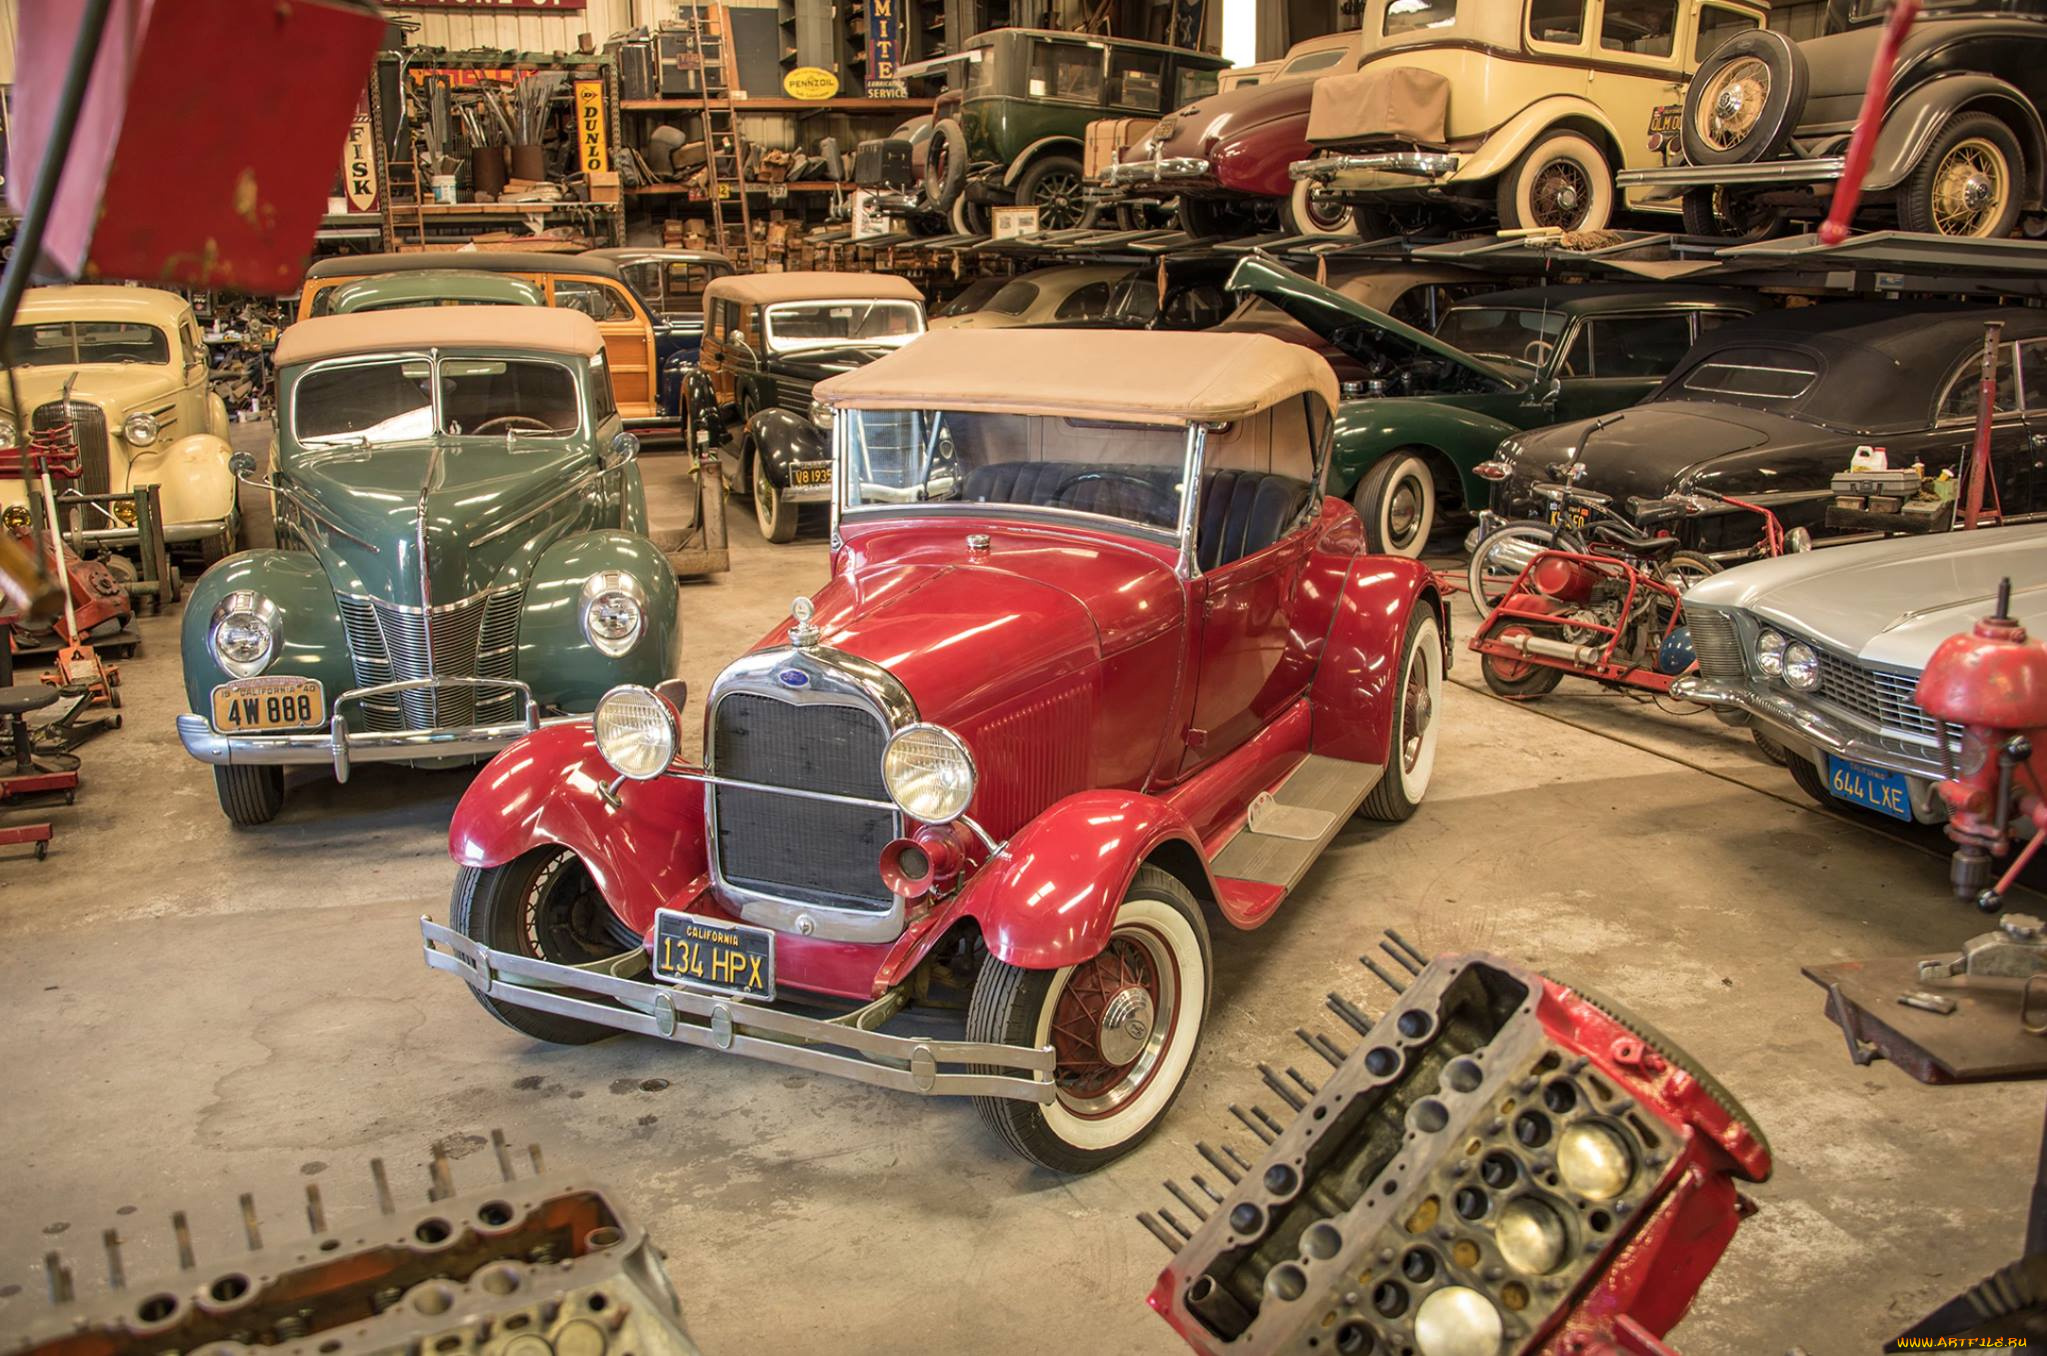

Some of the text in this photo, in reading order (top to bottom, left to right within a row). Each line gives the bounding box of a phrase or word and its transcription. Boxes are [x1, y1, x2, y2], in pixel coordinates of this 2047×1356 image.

[788, 79, 834, 88] PENNZOIL
[868, 88, 907, 98] SERVICE
[349, 126, 373, 195] FISK
[240, 686, 295, 697] CALIFORNIA
[229, 694, 312, 726] 4W 888
[1833, 768, 1905, 814] 644 LXE
[686, 925, 740, 947] CALIFORNIA
[660, 936, 764, 990] 134 HPX
